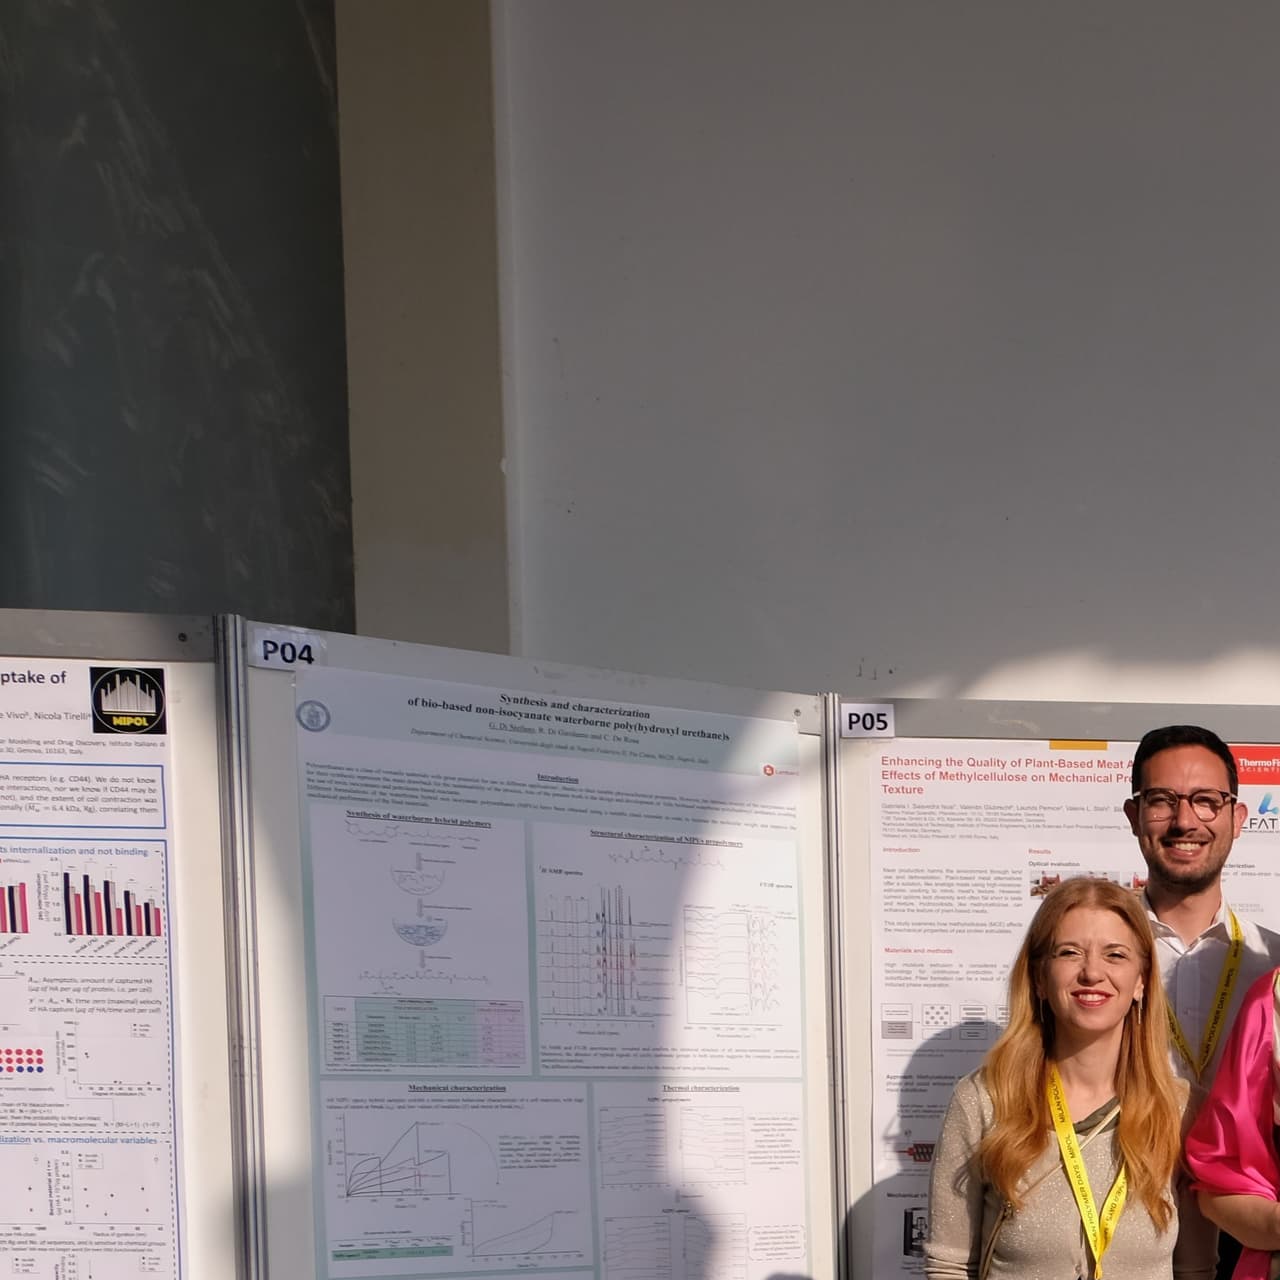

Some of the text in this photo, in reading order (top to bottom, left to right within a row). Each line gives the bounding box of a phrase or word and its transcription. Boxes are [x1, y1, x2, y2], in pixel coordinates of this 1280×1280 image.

[263, 640, 314, 665] P04
[0, 671, 67, 685] ptake of
[500, 694, 650, 720] Synthesis and characterization
[113, 717, 149, 727] MIPOL
[407, 697, 730, 742] of bio-based non-isocyanate waterborne poly(hydroxyl urethane)s
[848, 712, 888, 731] P05
[881, 756, 942, 769] Enhancing
[946, 757, 964, 768] the
[967, 757, 1007, 770] Quality
[1010, 758, 1022, 768] of
[1025, 758, 1093, 769] Plant-Based
[1097, 759, 1124, 770] Meat
[537, 773, 579, 784] Introduction
[881, 770, 921, 781] Effects
[924, 771, 936, 781] of
[939, 771, 1028, 783] Methylcellulose
[1031, 774, 1045, 782] on
[1049, 772, 1113, 783] Mechanical
[881, 785, 924, 795] Texture
[10, 846, 149, 858] internalization and not binding
[48, 1136, 118, 1144] macromolecular
